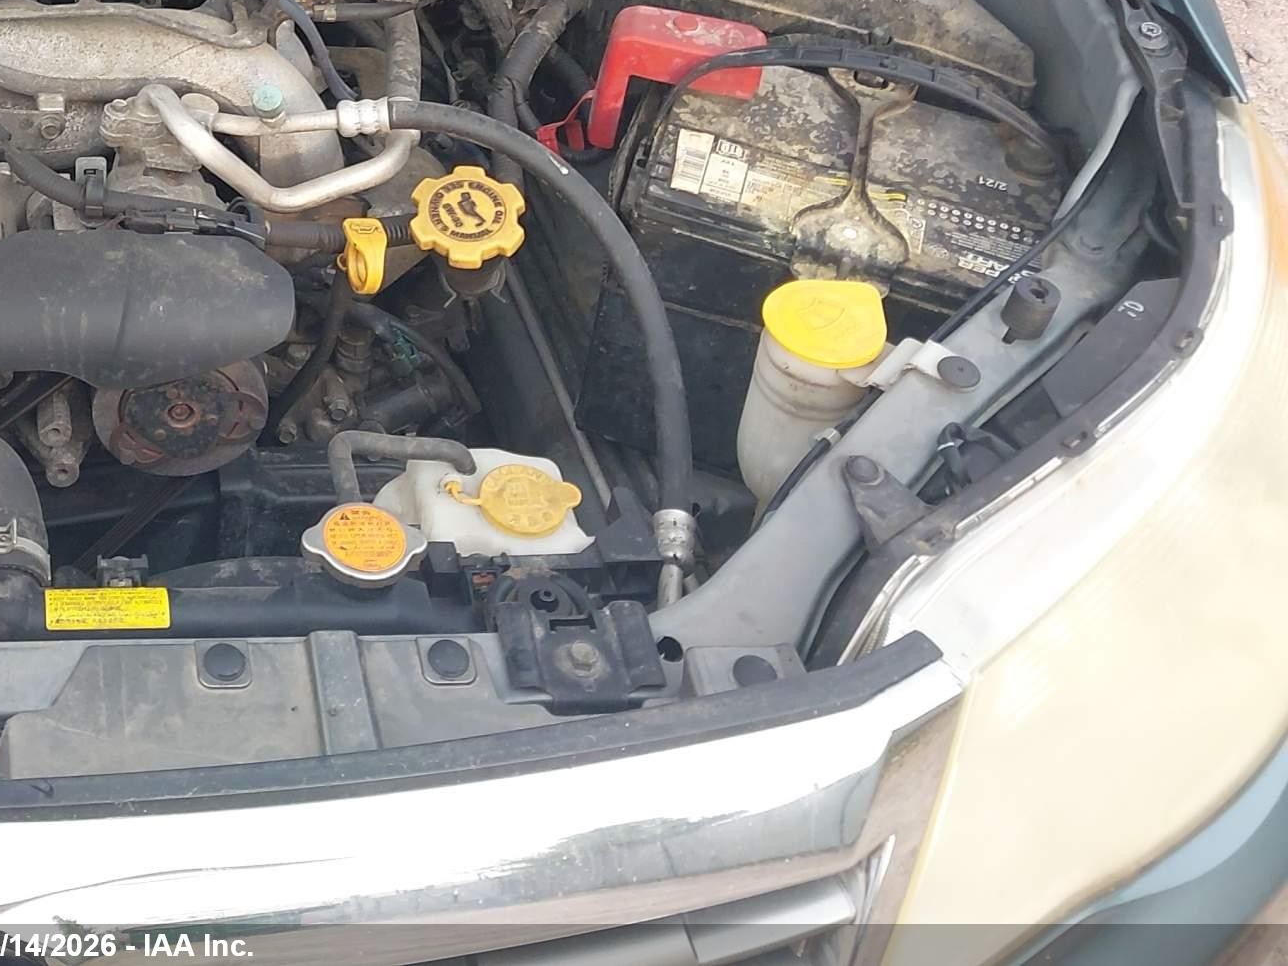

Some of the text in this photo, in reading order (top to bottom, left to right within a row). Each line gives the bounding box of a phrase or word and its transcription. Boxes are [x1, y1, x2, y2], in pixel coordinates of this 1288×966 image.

[977, 175, 1008, 191] 2/21
[468, 180, 504, 224] ENGINE OIL
